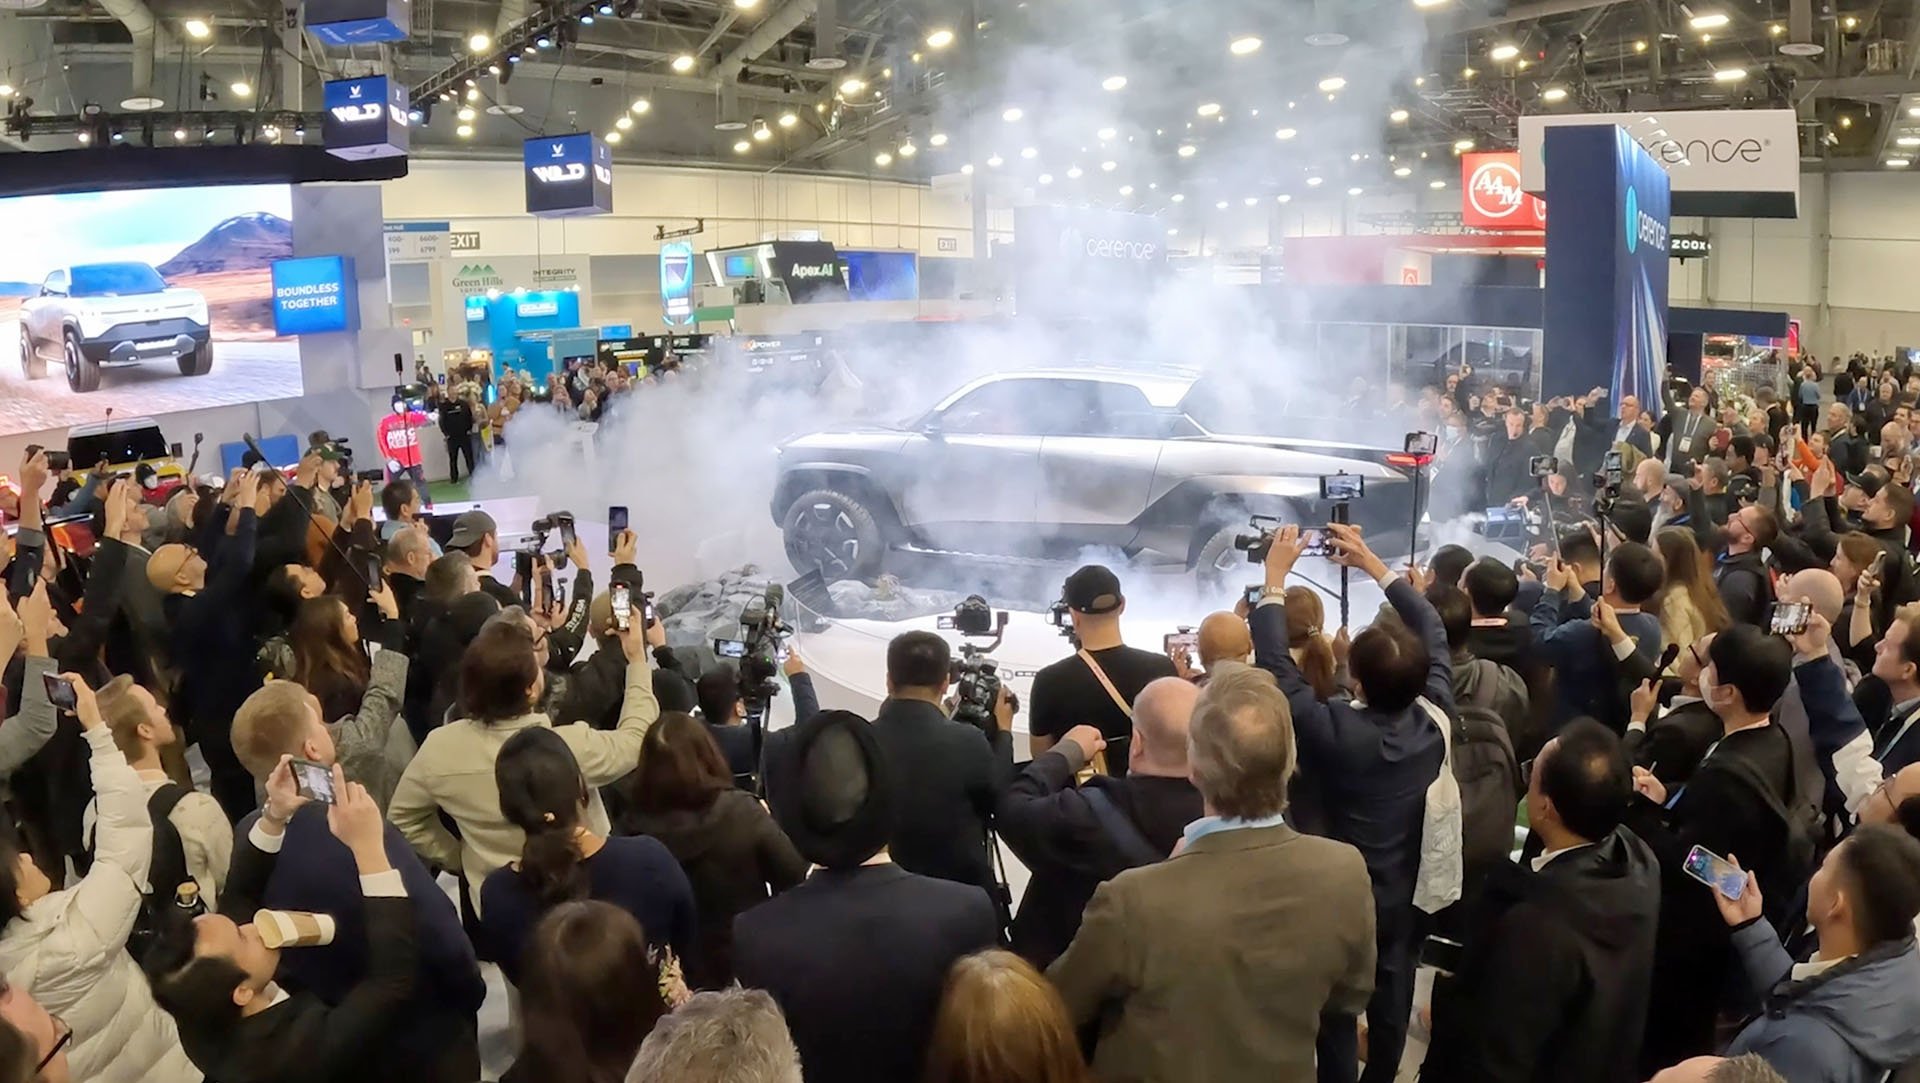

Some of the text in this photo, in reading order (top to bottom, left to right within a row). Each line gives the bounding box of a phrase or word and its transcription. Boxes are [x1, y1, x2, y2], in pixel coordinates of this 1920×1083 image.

[1473, 169, 1523, 206] AAM
[450, 234, 478, 248] EXIT
[1086, 238, 1154, 260] cerence
[452, 276, 504, 288] Green Hills
[277, 282, 340, 298] BOUNDLESS
[281, 296, 338, 310] TOGETHER
